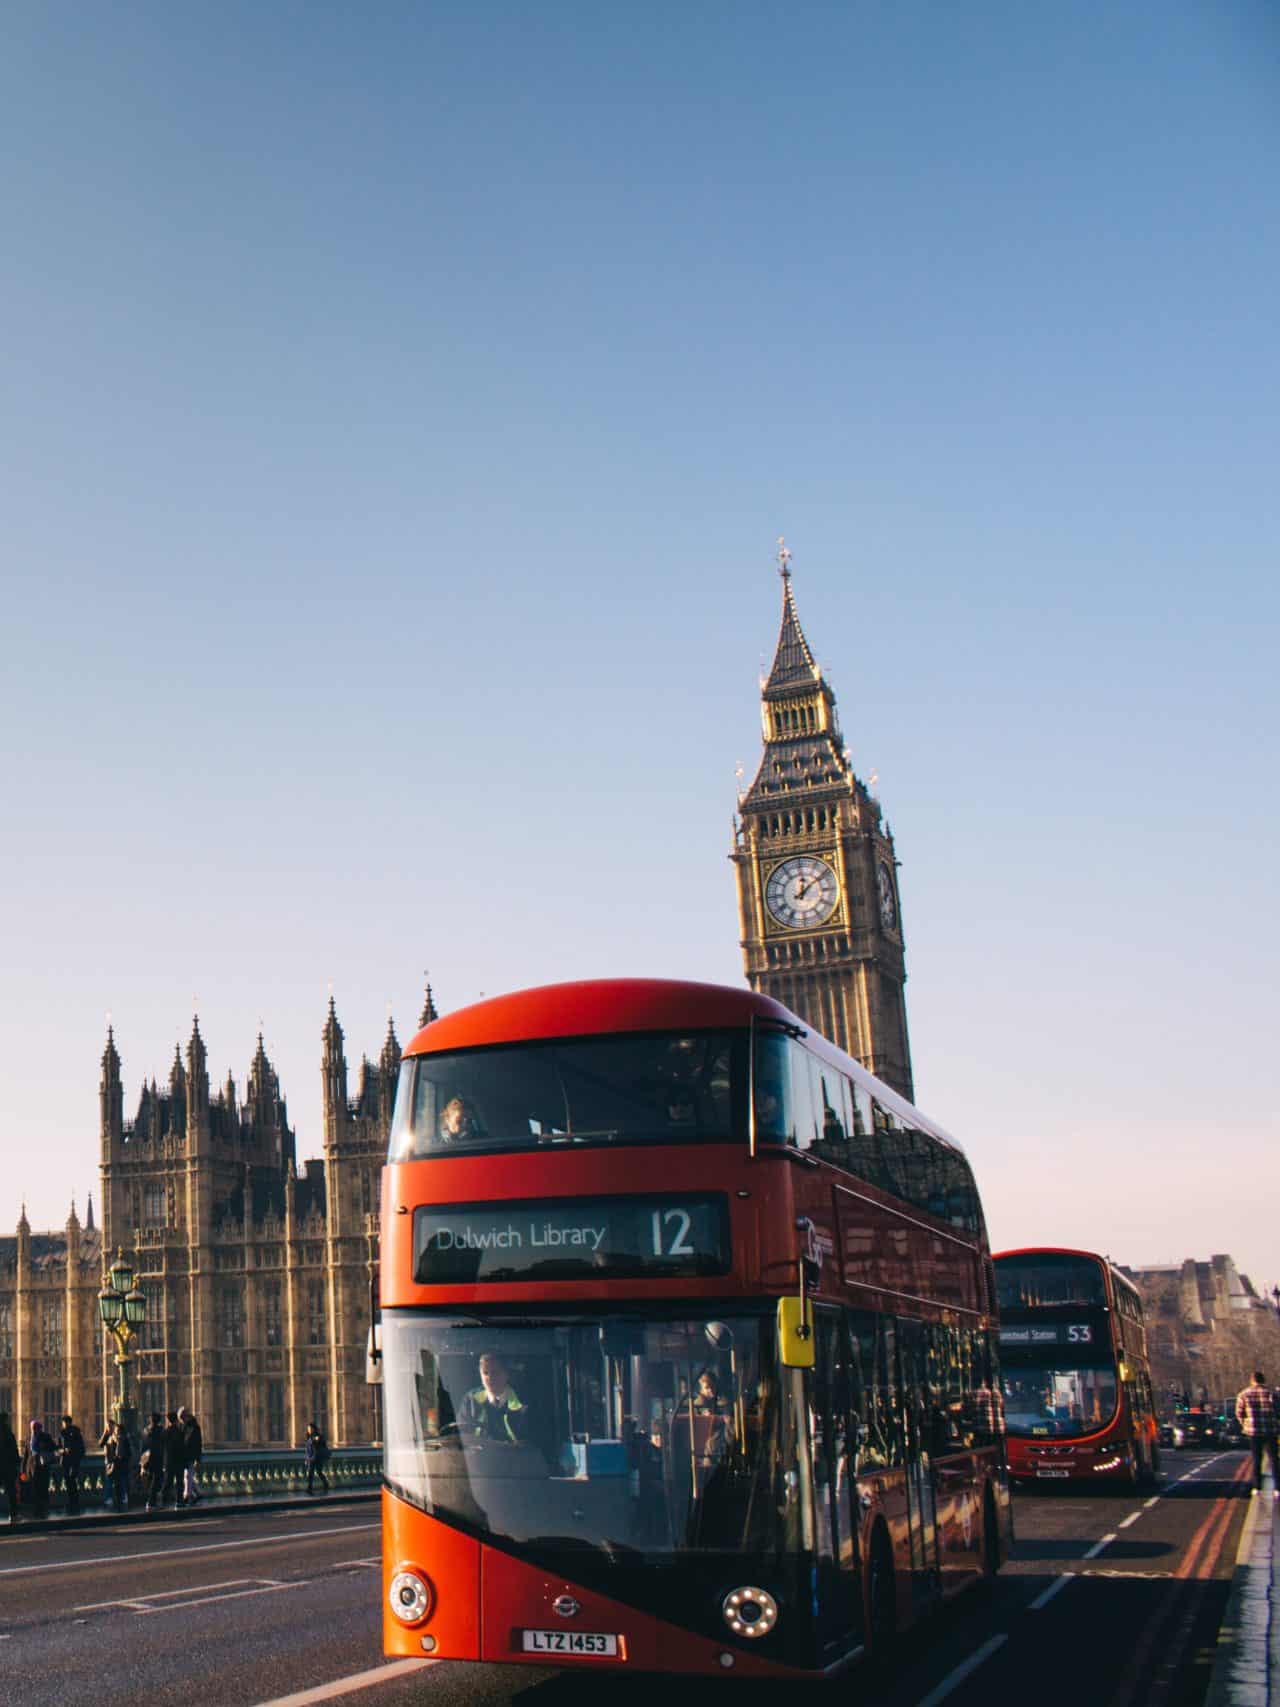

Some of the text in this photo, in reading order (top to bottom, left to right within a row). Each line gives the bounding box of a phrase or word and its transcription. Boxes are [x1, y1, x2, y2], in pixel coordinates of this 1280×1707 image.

[436, 1223, 606, 1250] Dulwich Library
[652, 1209, 693, 1256] 12
[1068, 1326, 1091, 1341] 53
[533, 1632, 607, 1652] LTZ 1453
